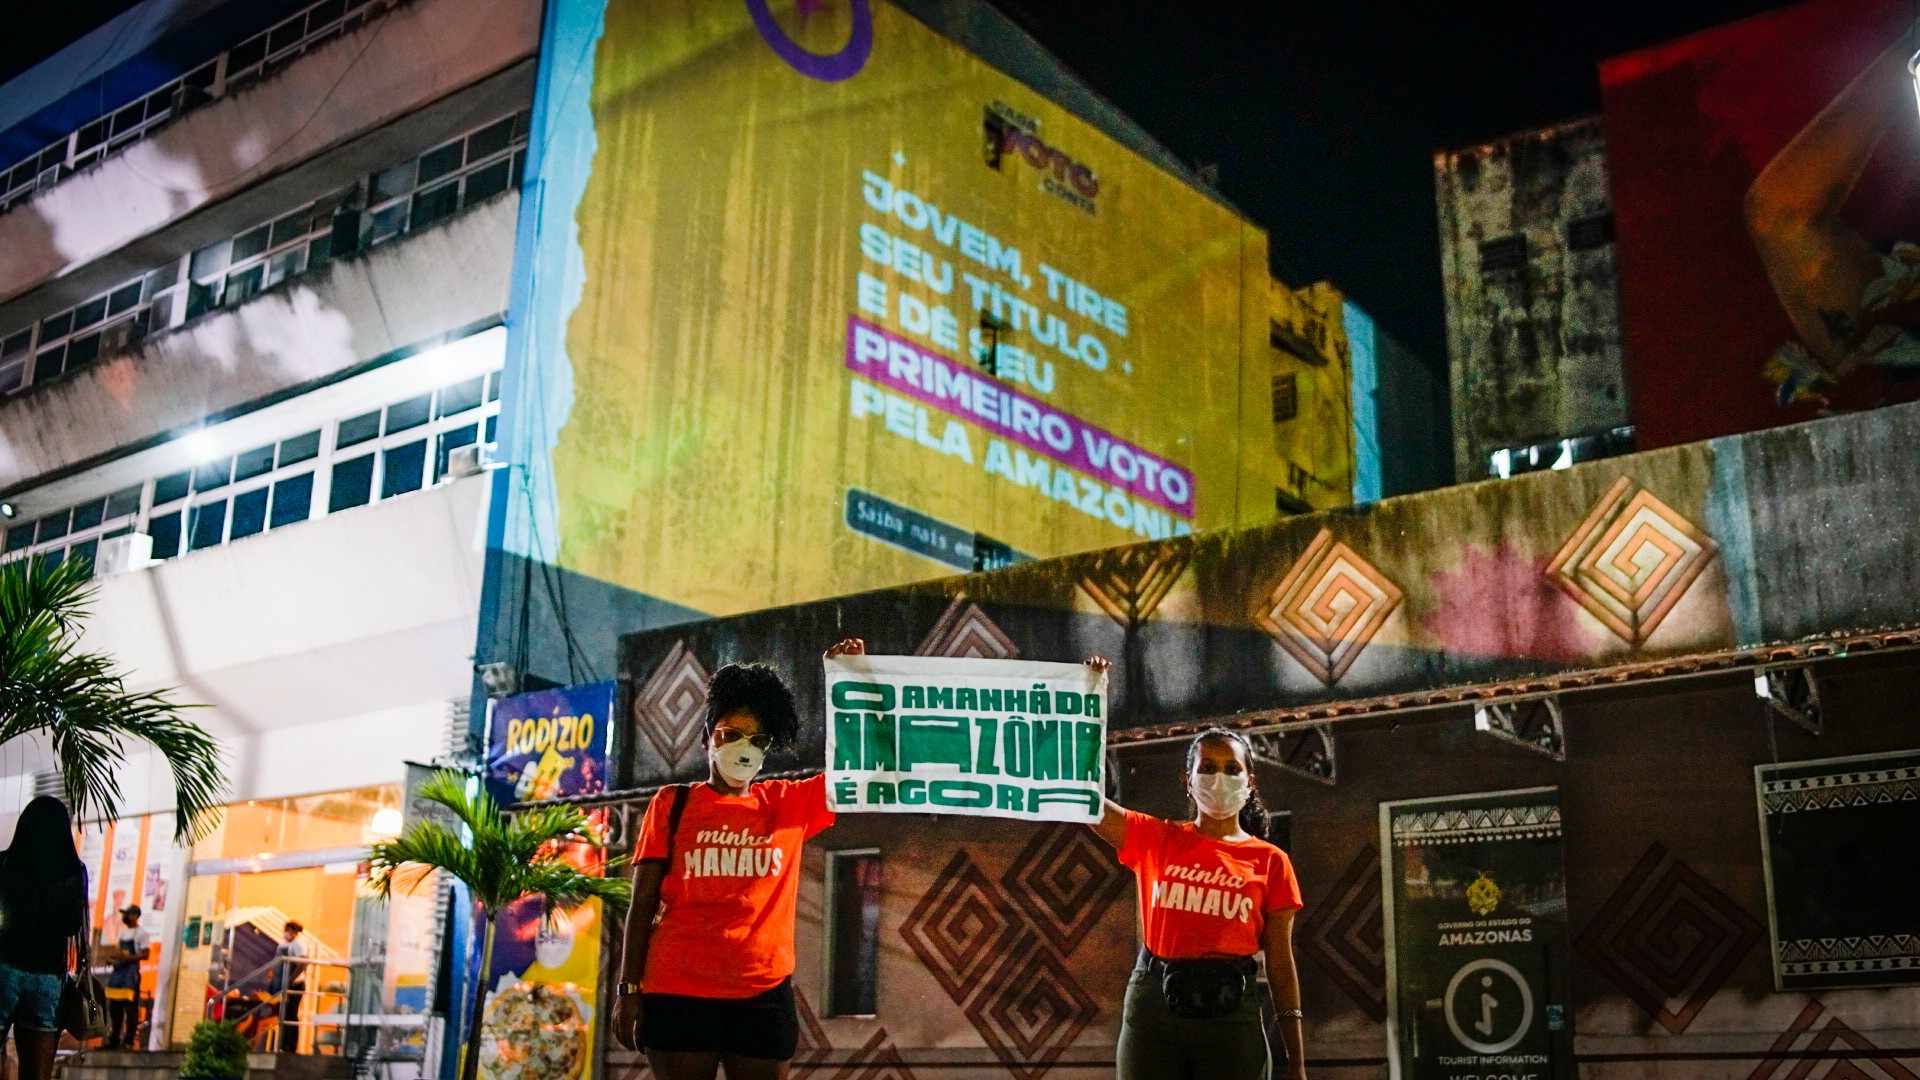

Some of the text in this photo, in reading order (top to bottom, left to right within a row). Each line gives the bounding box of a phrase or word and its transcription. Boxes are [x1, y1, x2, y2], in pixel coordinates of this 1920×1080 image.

[860, 223, 953, 294] SEU
[862, 169, 1128, 337] JOVEM, TIRE
[857, 272, 888, 318] E
[850, 379, 974, 464] PELA
[854, 325, 1190, 505] PRIMEIRO VOTO
[831, 681, 1101, 718] O AMANHÃ DA
[506, 705, 594, 757] RODÍZIO
[833, 711, 1101, 782] AMAZÔNIA
[834, 777, 1101, 816] É AGORA
[684, 847, 783, 879] MANAUS
[1164, 863, 1247, 889] minha
[1151, 880, 1253, 923] MANAUS
[1519, 917, 1532, 925] DO
[1438, 928, 1532, 946] AMAZONAS
[1438, 1055, 1548, 1065] TOURIST INFORMATION
